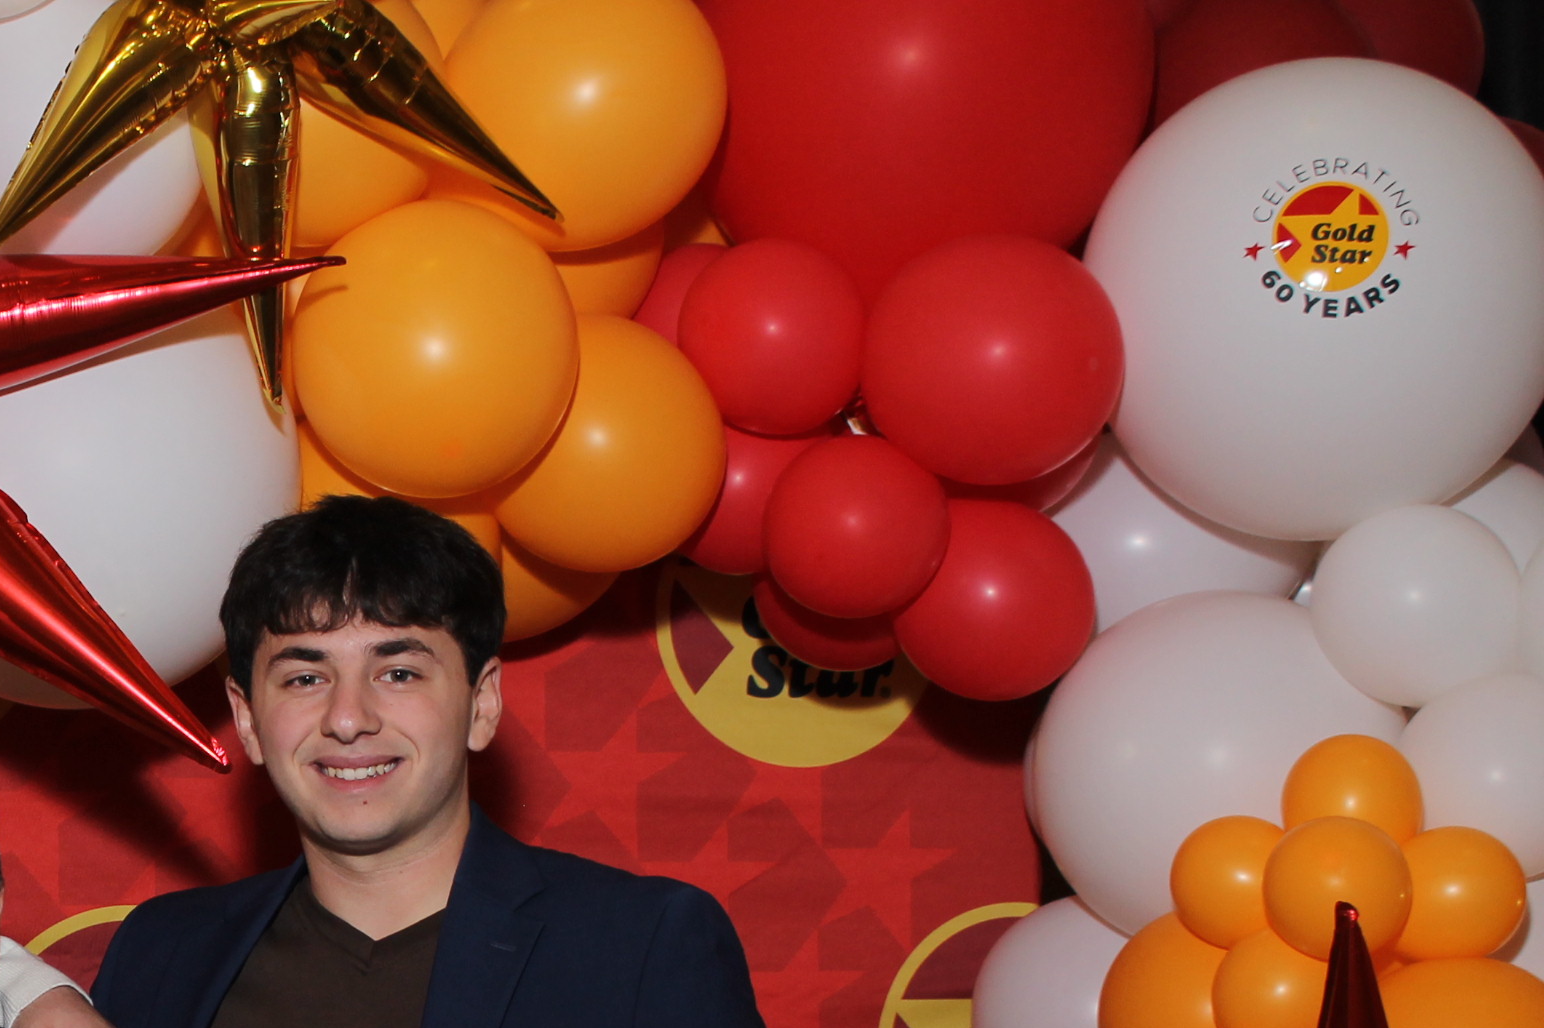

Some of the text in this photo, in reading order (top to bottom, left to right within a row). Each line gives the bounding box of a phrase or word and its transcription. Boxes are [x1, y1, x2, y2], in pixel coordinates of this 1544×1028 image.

[1252, 157, 1420, 226] CELEBRATING
[1311, 222, 1376, 243] Gold
[1311, 244, 1373, 264] Star
[1261, 270, 1401, 319] 60 YEARS
